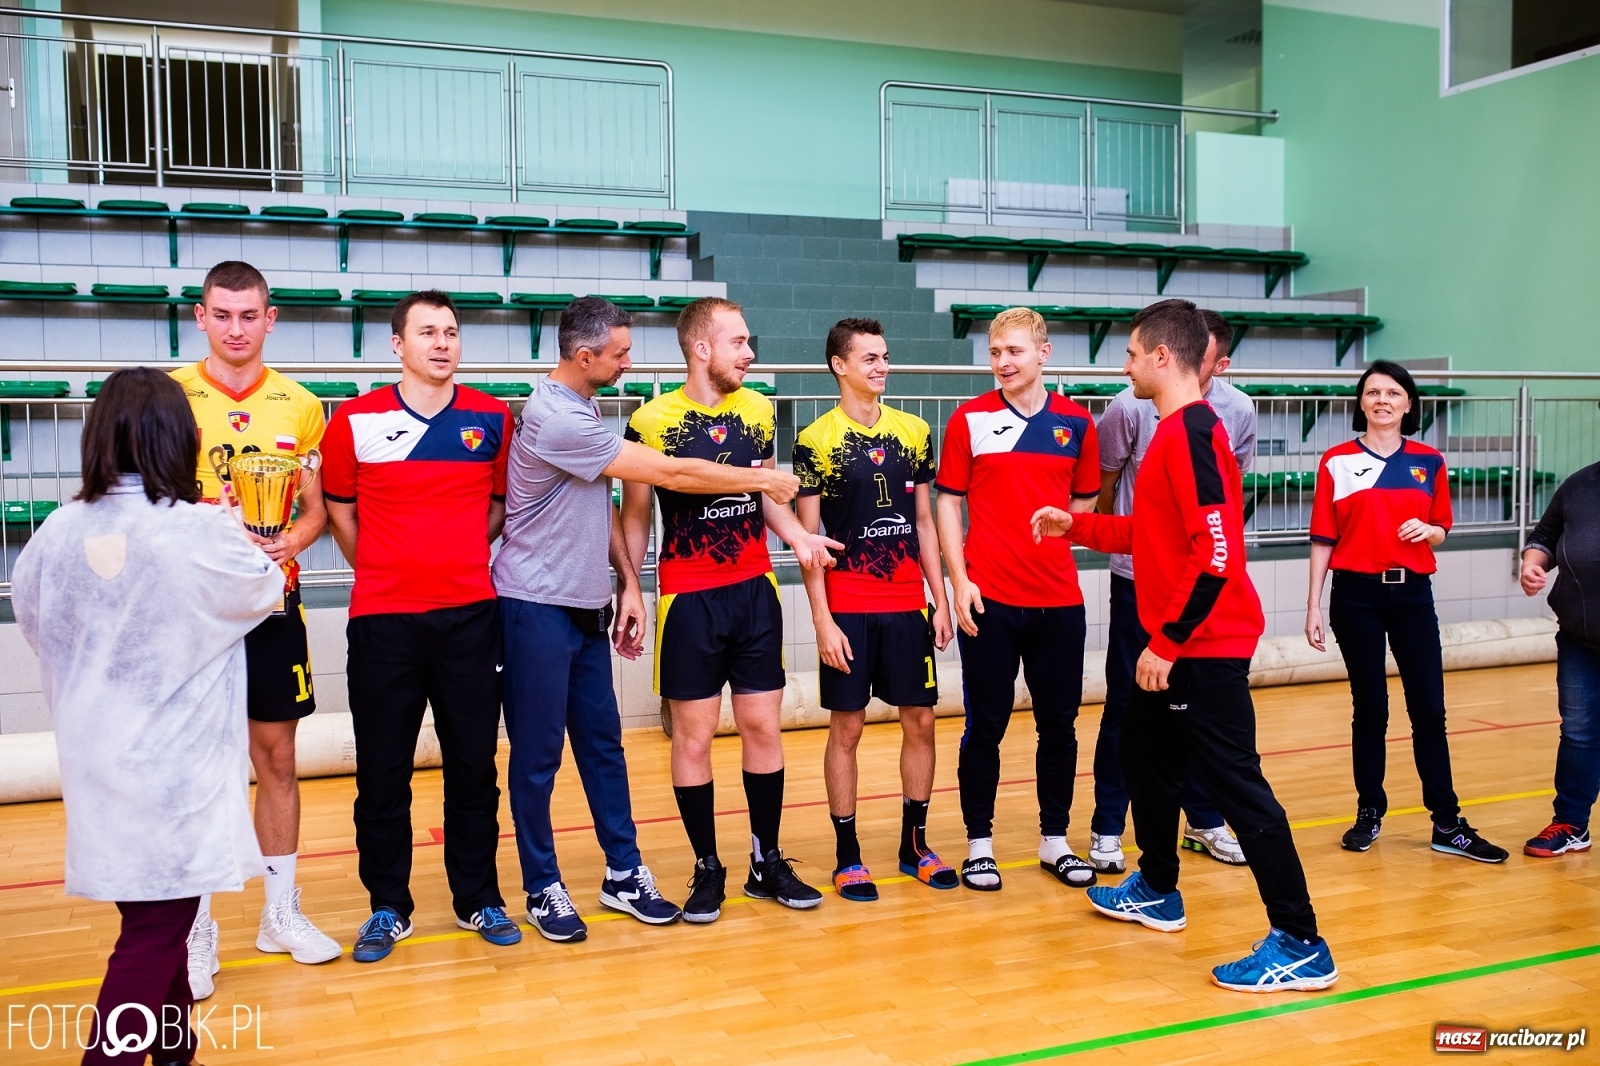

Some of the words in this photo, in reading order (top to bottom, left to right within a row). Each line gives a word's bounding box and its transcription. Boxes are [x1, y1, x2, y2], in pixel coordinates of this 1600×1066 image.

[873, 472, 892, 508] 1
[698, 501, 757, 520] Joanna
[858, 523, 912, 539] Joanna
[1206, 510, 1228, 573] Joma
[924, 655, 936, 689] 1
[961, 860, 998, 875] adida
